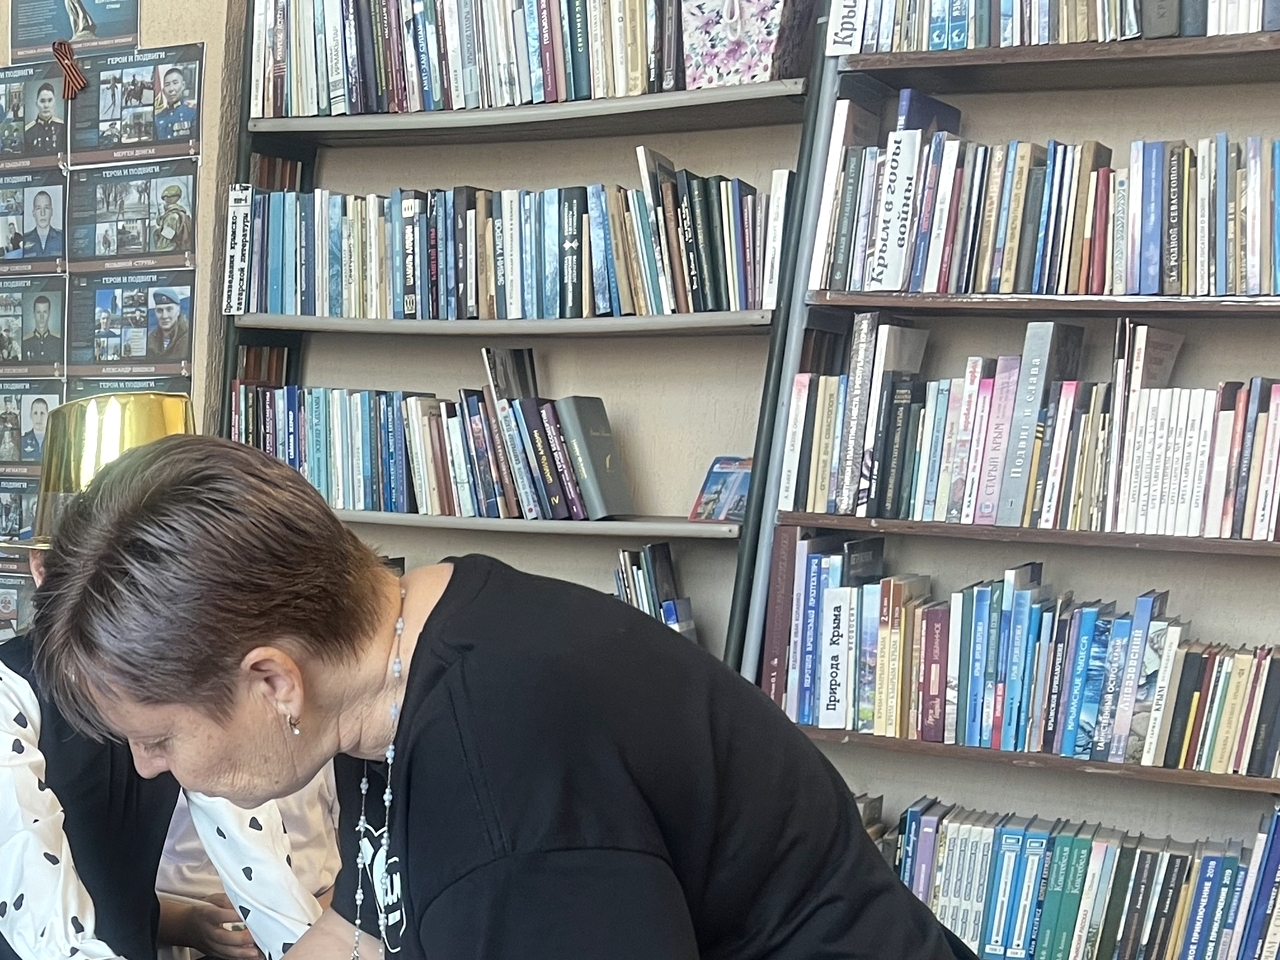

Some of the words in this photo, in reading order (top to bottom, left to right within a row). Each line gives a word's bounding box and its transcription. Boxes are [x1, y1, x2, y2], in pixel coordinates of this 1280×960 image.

[5, 68, 34, 79] ПОДВИГИ
[107, 55, 126, 65] ГЕРОИ
[134, 51, 166, 62] ПОДВИГИ
[5, 175, 32, 185] ПОДВИГИ
[102, 169, 121, 178] ГЕРОИ
[129, 165, 160, 176] ПОДВИГИ
[886, 138, 903, 195] годы
[883, 201, 894, 212] в
[1169, 155, 1179, 223] СЕВАСТОПОЛЬ
[227, 210, 239, 250] крымско-
[896, 175, 915, 248] войны
[237, 211, 250, 263] литературы
[493, 218, 505, 255] УМЕРОВ
[870, 218, 891, 285] Крым
[1169, 227, 1179, 266] РОДНОЙ
[224, 254, 236, 314] Произведения
[235, 267, 246, 312] татарской
[496, 256, 506, 286] ЭРВИН
[1170, 270, 1178, 282] ЗА
[858, 319, 869, 343] КРЫМ
[853, 343, 867, 389] РЕСПУБЛИКЕ
[1025, 358, 1041, 402] слава
[822, 393, 835, 440] СЕВАСТОПОЛЯ
[850, 396, 861, 420] МЕСТА
[1024, 409, 1033, 417] и
[846, 420, 858, 460] ПАМЯТНЫЕ
[991, 422, 1005, 452] КРЫМ
[1009, 425, 1030, 478] Подвиг
[840, 466, 853, 509] ПАМЯТНИКИ
[985, 456, 1000, 496] СТАРЫЙ
[829, 605, 842, 647] Крыма
[933, 622, 942, 660] ИЗБРАННОЕ
[1049, 643, 1064, 693] ПРИКЛЮЧЕНИЕ
[1111, 639, 1123, 661] КРЫМ
[826, 654, 841, 711] Природа
[1066, 676, 1082, 730] КРЫМСКИЕ
[1075, 635, 1089, 675] ЧУДЕСА
[1106, 661, 1119, 692] ОСТРОВ
[1153, 685, 1166, 712] КРЫМ
[1096, 693, 1114, 751] ТАИНСТВЕННЫЙ
[1053, 846, 1070, 892] Коктебеля
[1072, 849, 1088, 894] Коктебеля
[1077, 909, 1090, 934] РАССКАЗ
[1190, 881, 1212, 943] ПРИКЛЮЧЕНИЕ
[1206, 860, 1218, 878] 2018
[1209, 886, 1229, 941] ПРИКЛЮЧЕНИЕ
[1222, 869, 1233, 885] 2019
[1031, 907, 1042, 939] MICKIEWICZ
[1028, 940, 1037, 955] Adam
